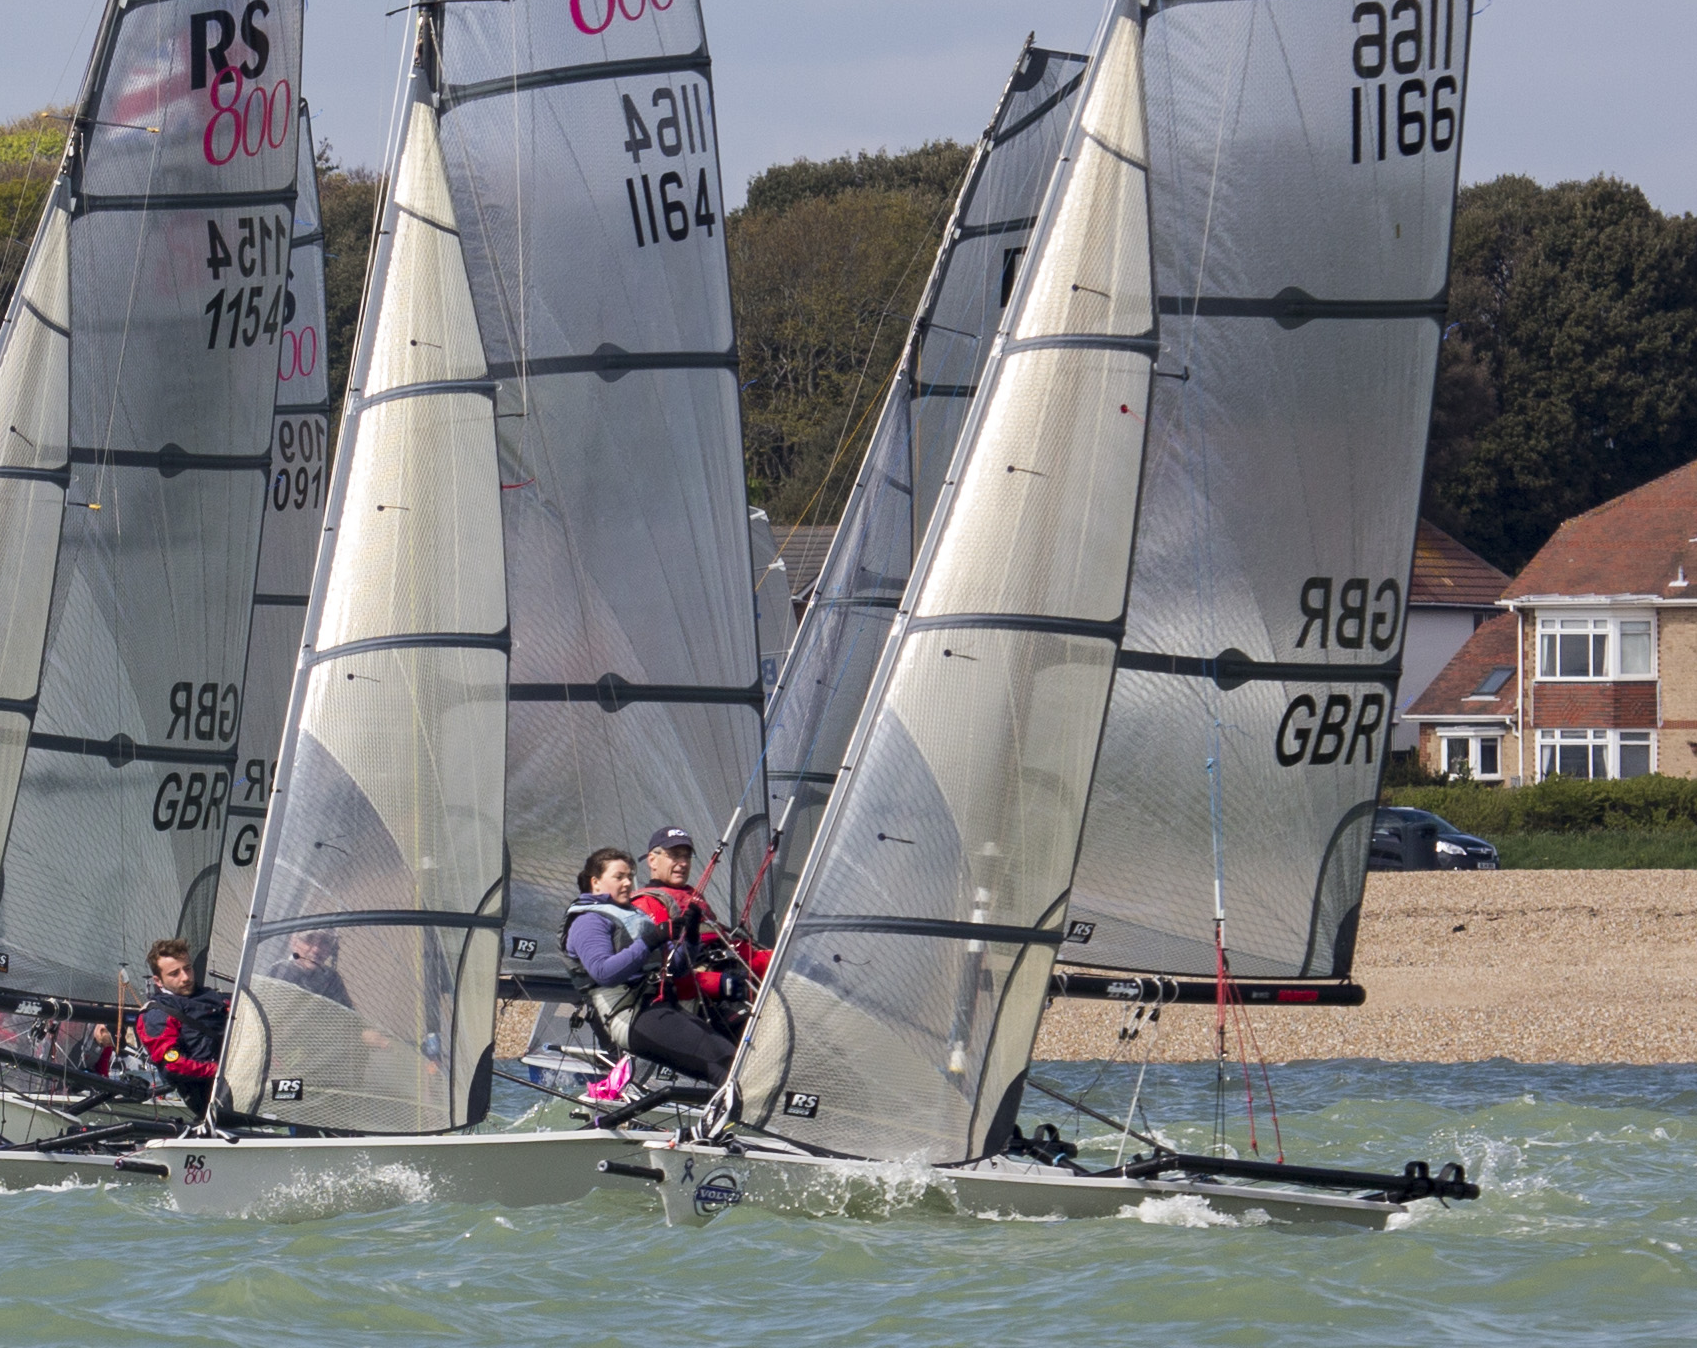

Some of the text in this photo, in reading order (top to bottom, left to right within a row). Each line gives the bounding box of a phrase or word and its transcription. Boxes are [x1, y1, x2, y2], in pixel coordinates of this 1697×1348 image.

[190, 0, 270, 91] RS
[203, 65, 291, 167] 800
[1351, 74, 1456, 165] 1166
[625, 167, 715, 249] 1164
[205, 284, 282, 350] 1154
[279, 326, 317, 381] 00
[273, 465, 322, 511] 091
[1275, 694, 1384, 767] GBR
[152, 771, 228, 832] GBR
[517, 940, 536, 953] RS
[1073, 923, 1094, 936] RS
[278, 1080, 301, 1092] RS
[792, 1093, 818, 1108] RS
[184, 1154, 206, 1170] RS
[184, 1164, 212, 1185] 800
